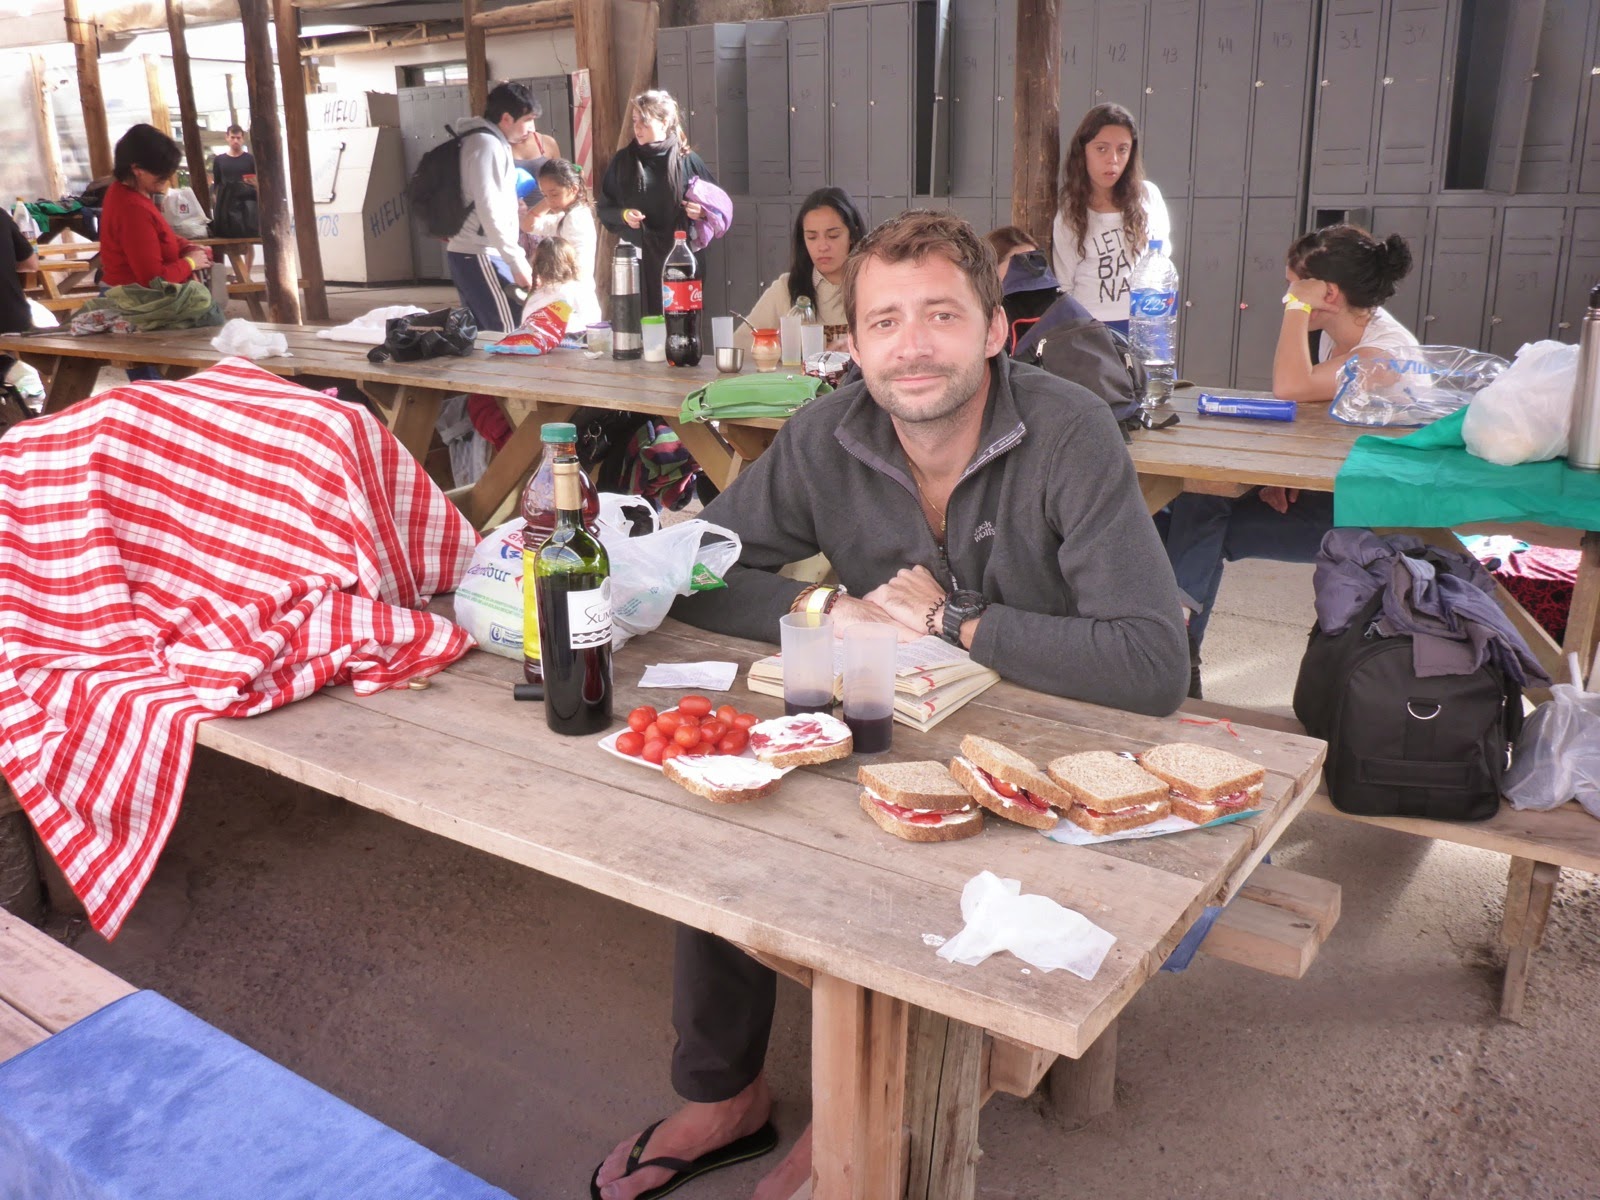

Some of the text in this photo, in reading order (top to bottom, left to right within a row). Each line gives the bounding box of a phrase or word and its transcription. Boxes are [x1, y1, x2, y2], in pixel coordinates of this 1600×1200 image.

[1107, 42, 1127, 63] 42
[1162, 47, 1179, 64] 43
[323, 100, 359, 124] HIELO
[1097, 248, 1132, 280] BA
